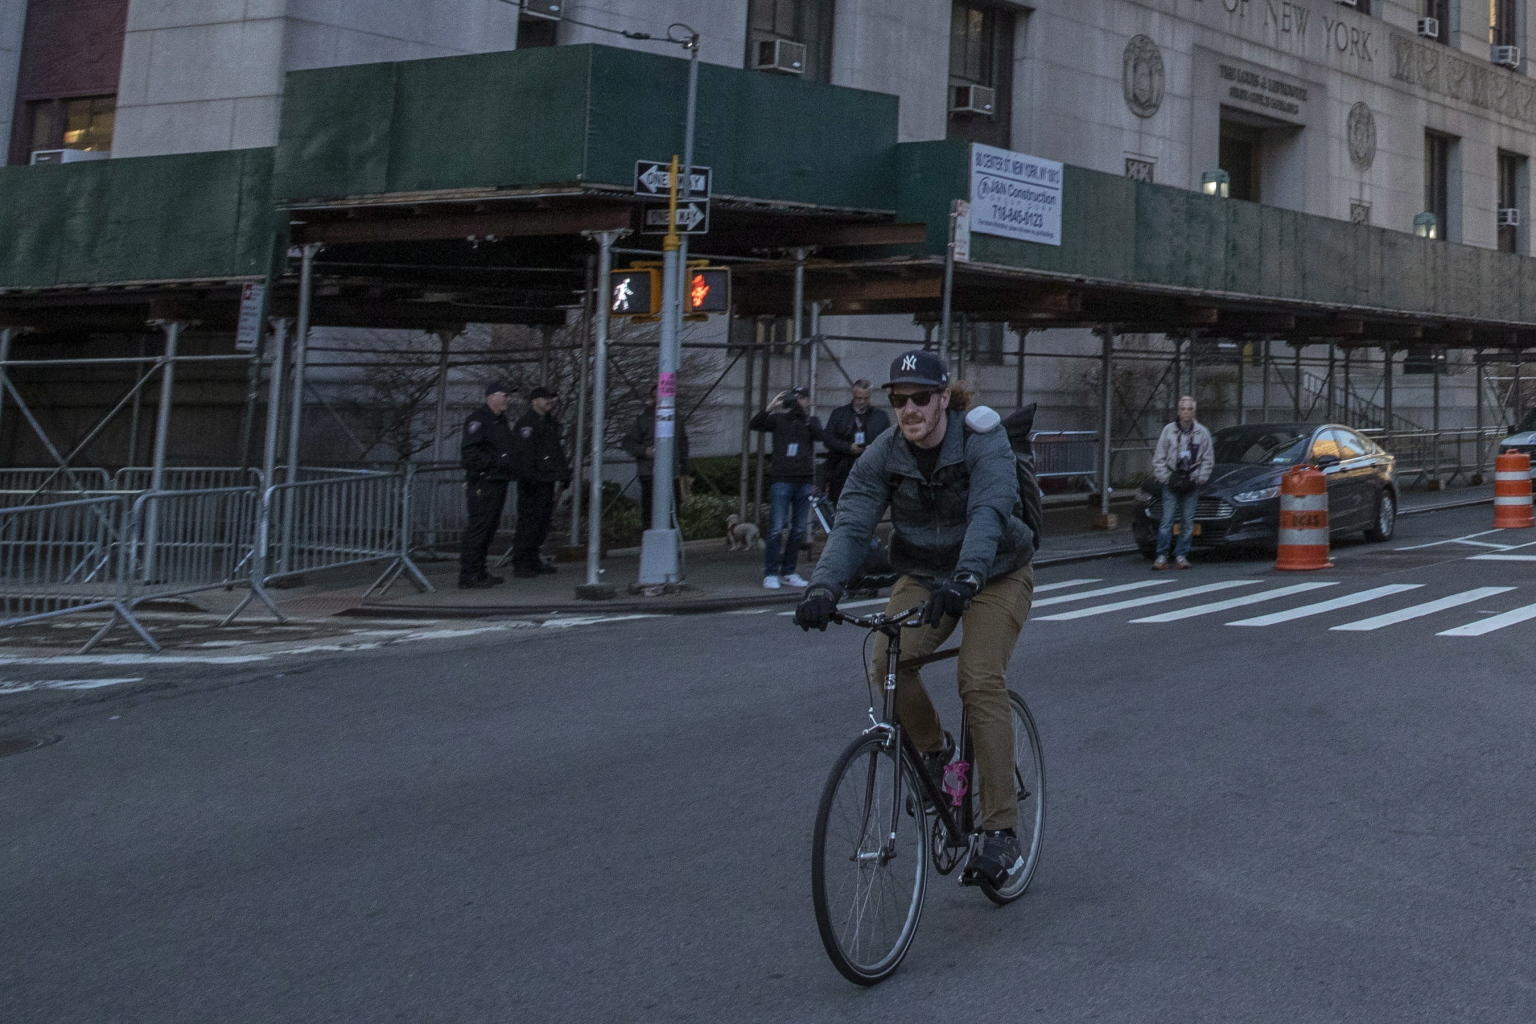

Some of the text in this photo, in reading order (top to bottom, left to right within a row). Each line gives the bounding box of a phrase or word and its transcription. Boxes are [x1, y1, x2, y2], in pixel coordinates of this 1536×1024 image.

[1322, 15, 1373, 63] YORK
[647, 172, 668, 186] ONE
[1007, 183, 1057, 206] Construction
[901, 353, 918, 372] NY
